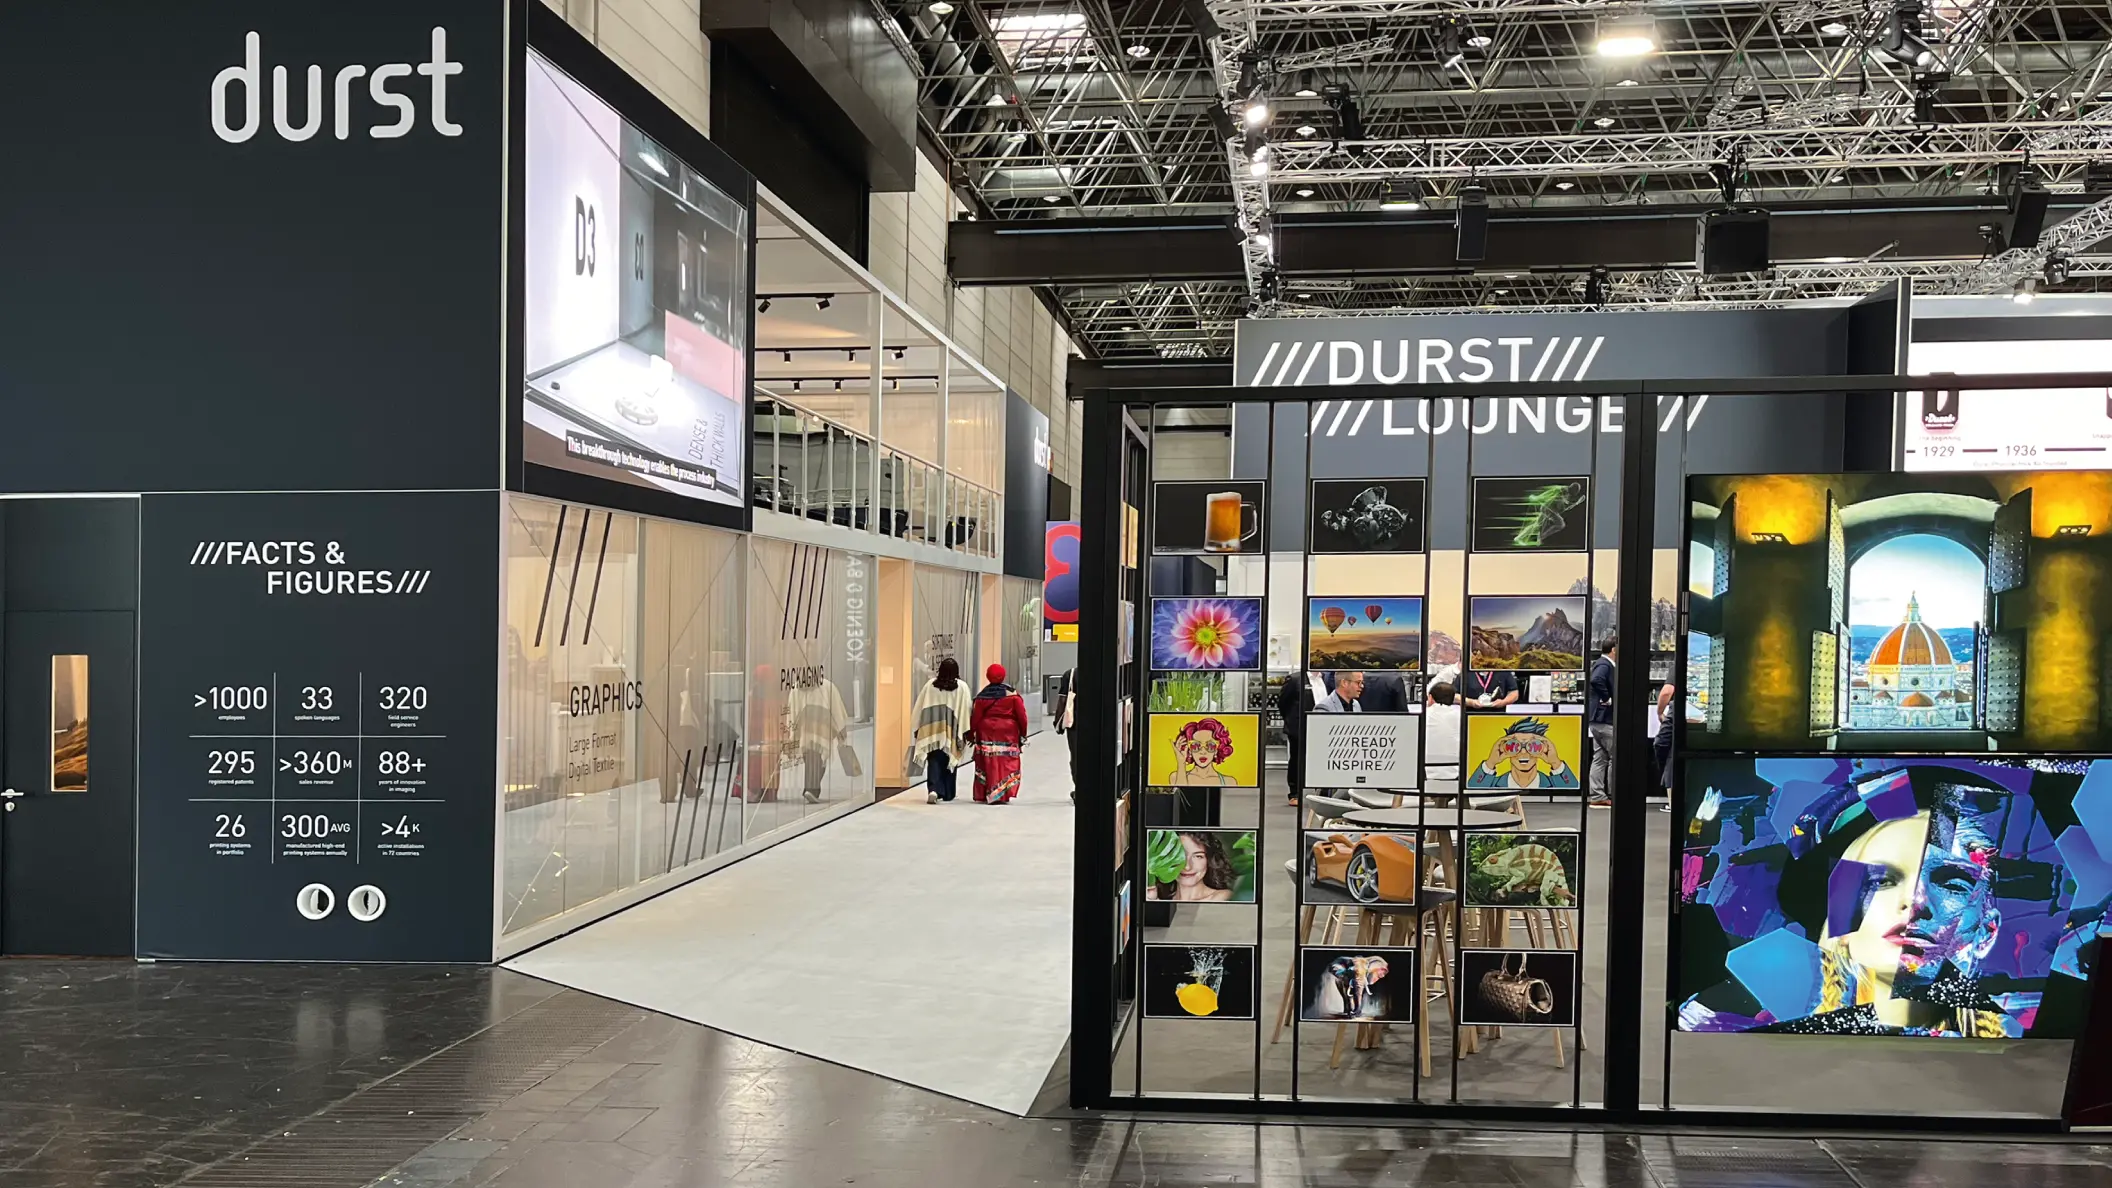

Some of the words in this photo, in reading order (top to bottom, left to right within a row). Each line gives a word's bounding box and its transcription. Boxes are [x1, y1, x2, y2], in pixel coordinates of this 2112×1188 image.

[211, 26, 463, 143] durst
[575, 195, 596, 278] D3
[688, 424, 707, 460] DENSE
[710, 437, 725, 469] THICK
[1924, 445, 1955, 457] 1929
[2005, 445, 2037, 457] 1936
[567, 435, 581, 454] This
[581, 440, 621, 467] breakthrough
[621, 451, 650, 473] technology
[651, 459, 670, 475] enables
[670, 463, 679, 477] the
[679, 468, 697, 481] process
[697, 469, 715, 488] industry
[325, 541, 346, 565] &
[780, 664, 824, 691] PACKAGING
[194, 686, 267, 710] >1000
[301, 686, 333, 710] 33
[379, 686, 427, 710] 320
[570, 680, 644, 718] GRAPHICS
[569, 736, 591, 755] Large
[592, 732, 617, 749] Format
[208, 750, 255, 774] 295
[378, 751, 426, 774] 88+
[568, 759, 592, 782] Digital
[593, 755, 615, 773] Textile
[215, 814, 246, 838] 26
